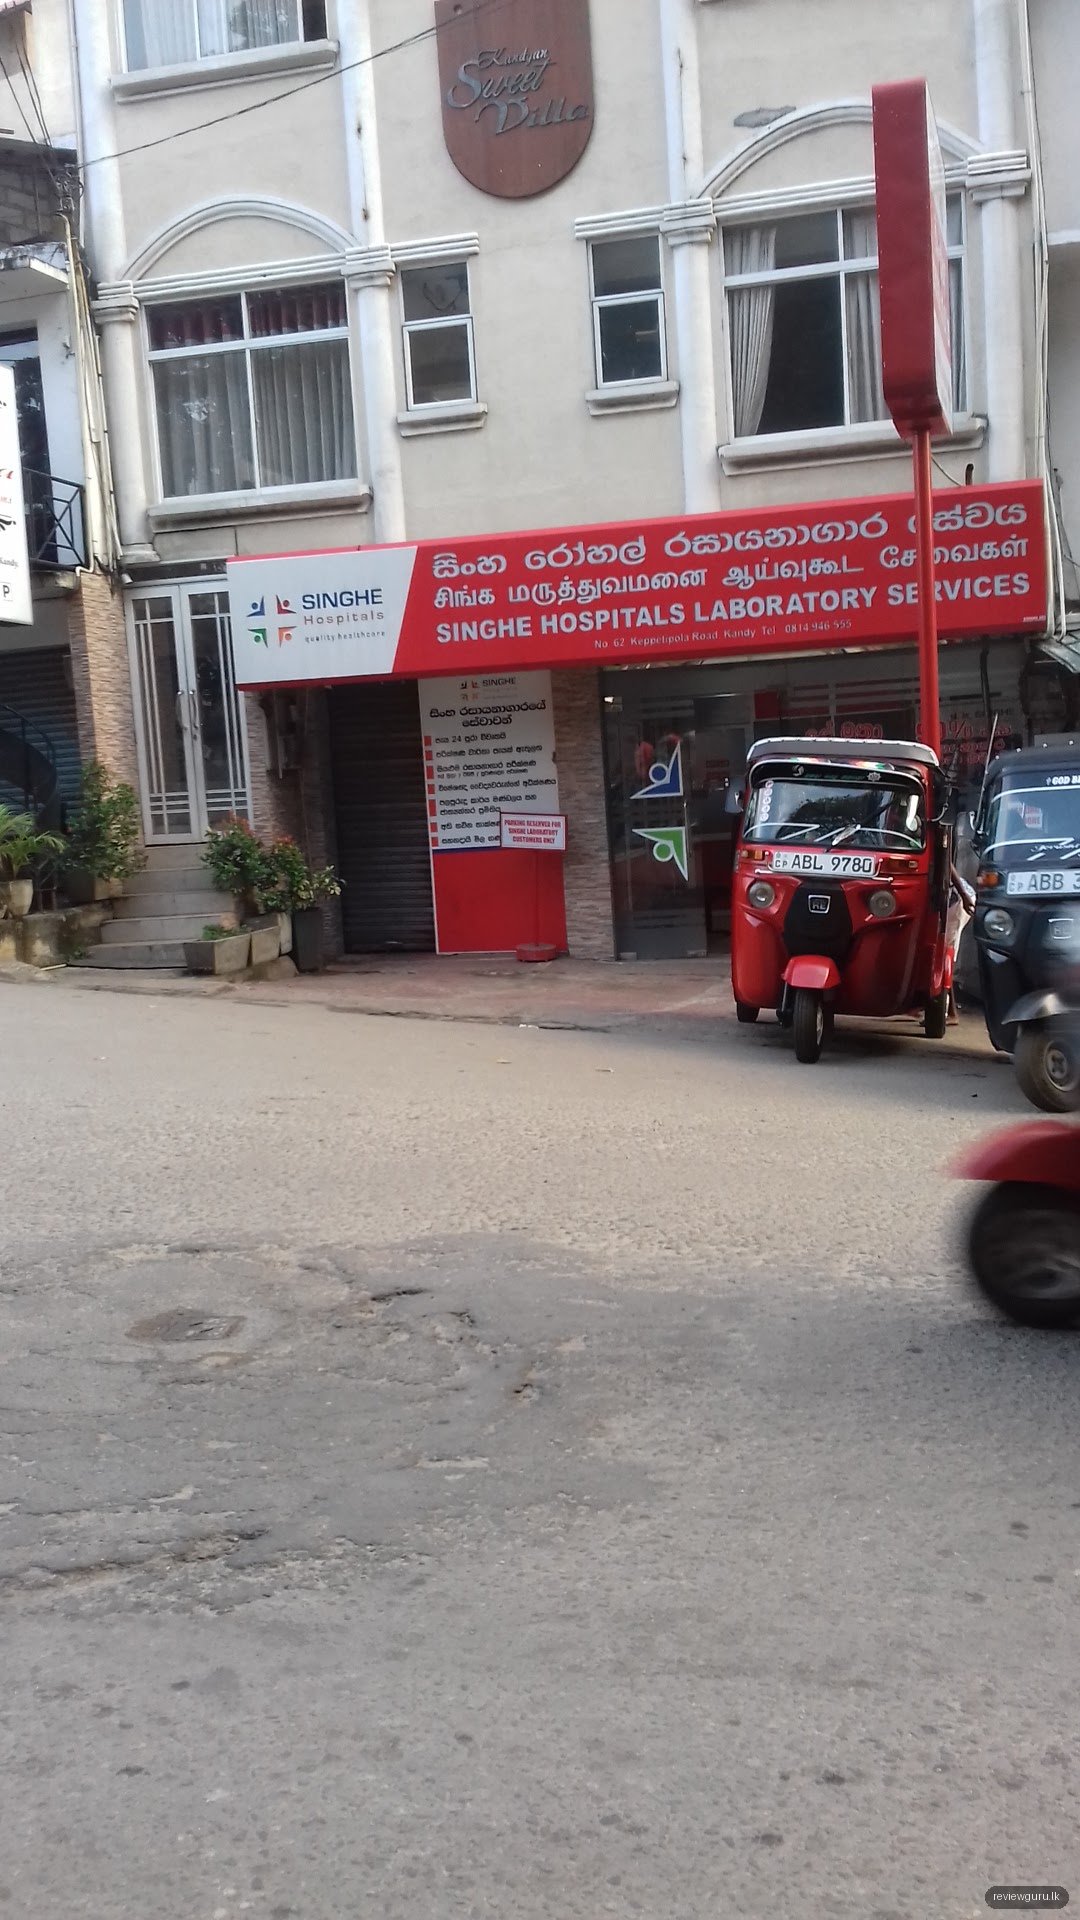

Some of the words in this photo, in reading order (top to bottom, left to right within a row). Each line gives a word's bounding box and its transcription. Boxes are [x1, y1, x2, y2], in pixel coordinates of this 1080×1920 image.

[478, 49, 549, 69] Kandyan
[447, 60, 557, 109] Sweet
[475, 98, 589, 135] Villa
[433, 552, 507, 578] සිංහ
[524, 534, 646, 570] රෝහල්
[664, 511, 889, 558] රසායනාගාර
[434, 585, 496, 608] சிங்க
[508, 568, 708, 606] மருத்துவமனை
[722, 555, 864, 590] ஆய்வுகூட
[302, 588, 383, 610] SINGHE
[304, 610, 385, 626] Hospitals
[436, 616, 533, 644] SINGHE
[541, 603, 686, 635] HOSPITALS
[694, 586, 878, 622] LABORATORY
[305, 633, 335, 644] quality
[337, 631, 385, 641] healthcare
[613, 638, 625, 648] 62
[724, 628, 756, 639] Kandy
[785, 623, 809, 633] 0814
[812, 621, 830, 631] 946
[833, 619, 852, 629] 555
[482, 676, 517, 688] SINGHE
[1052, 776, 1070, 785] GOD
[791, 854, 823, 870] ABL
[831, 857, 873, 873] 9780
[1027, 873, 1064, 891] ABB
